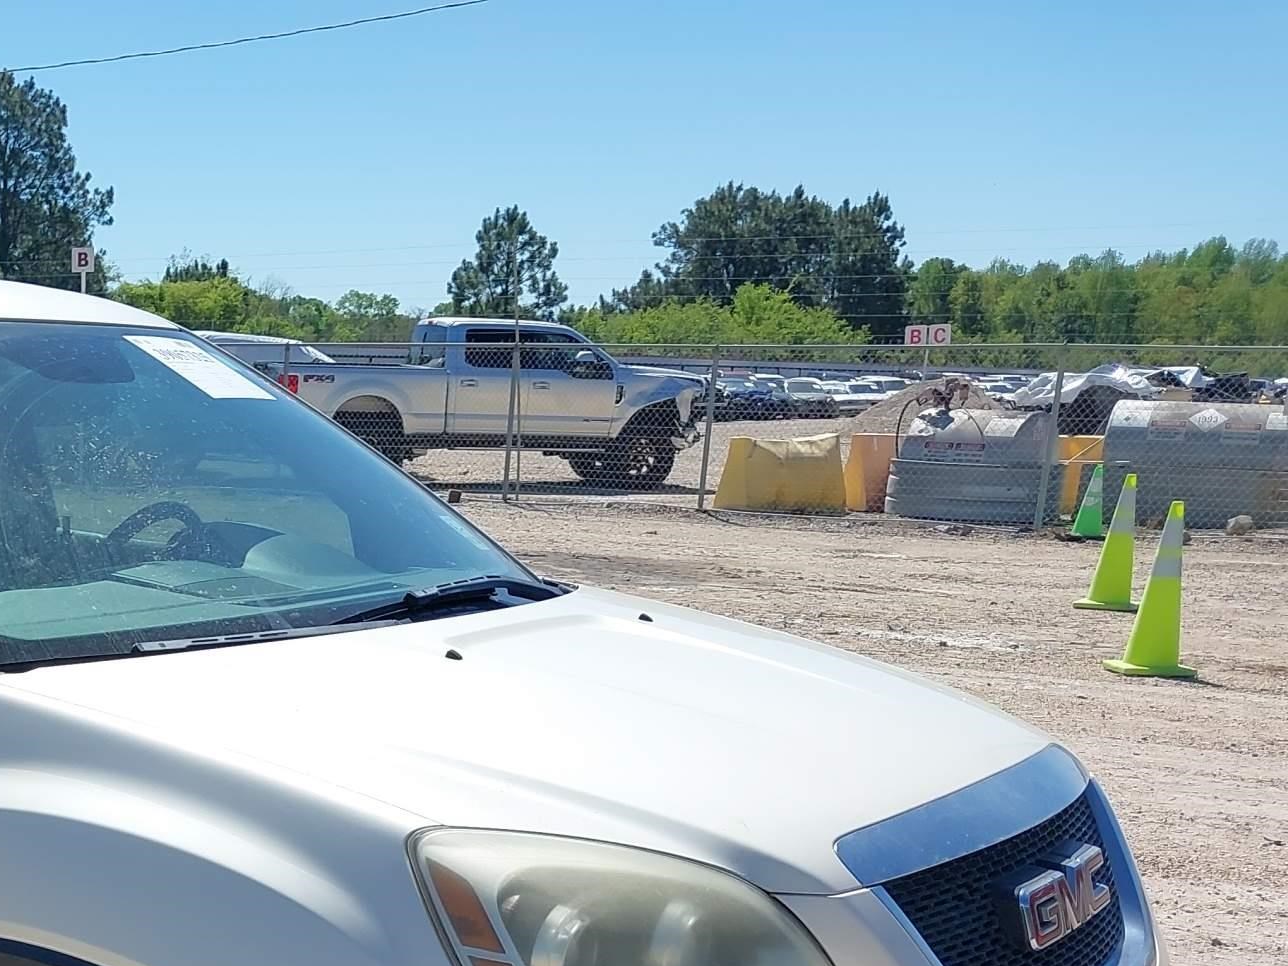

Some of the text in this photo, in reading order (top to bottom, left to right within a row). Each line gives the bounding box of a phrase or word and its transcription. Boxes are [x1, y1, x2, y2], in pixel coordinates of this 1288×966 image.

[78, 252, 88, 267] B
[911, 329, 921, 344] B
[934, 328, 946, 343] C
[1014, 843, 1111, 951] GMC
